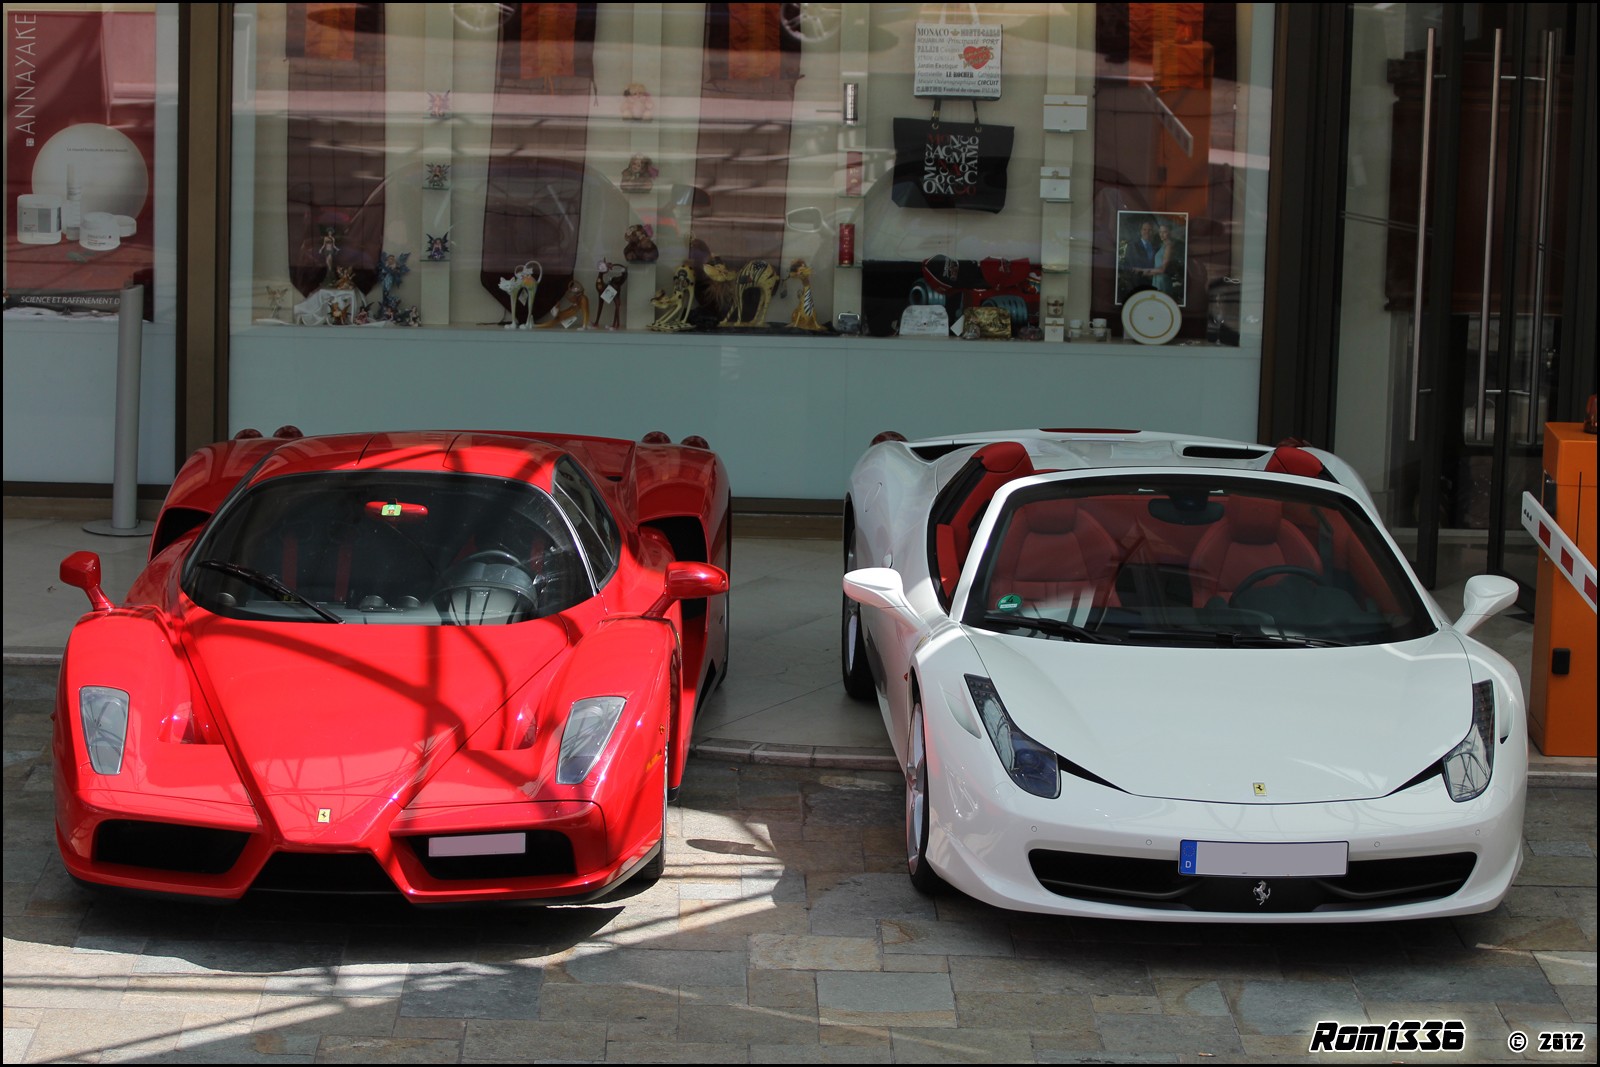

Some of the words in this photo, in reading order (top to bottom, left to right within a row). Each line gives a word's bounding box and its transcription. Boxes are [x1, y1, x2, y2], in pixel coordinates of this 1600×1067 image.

[917, 28, 949, 37] MONACO
[14, 14, 37, 135] ANNAYAKE
[20, 295, 52, 304] SCIENCE
[52, 296, 62, 304] ET
[62, 296, 112, 305] RAFFINEMENT
[1006, 595, 1014, 603] 4
[1185, 860, 1192, 869] D
